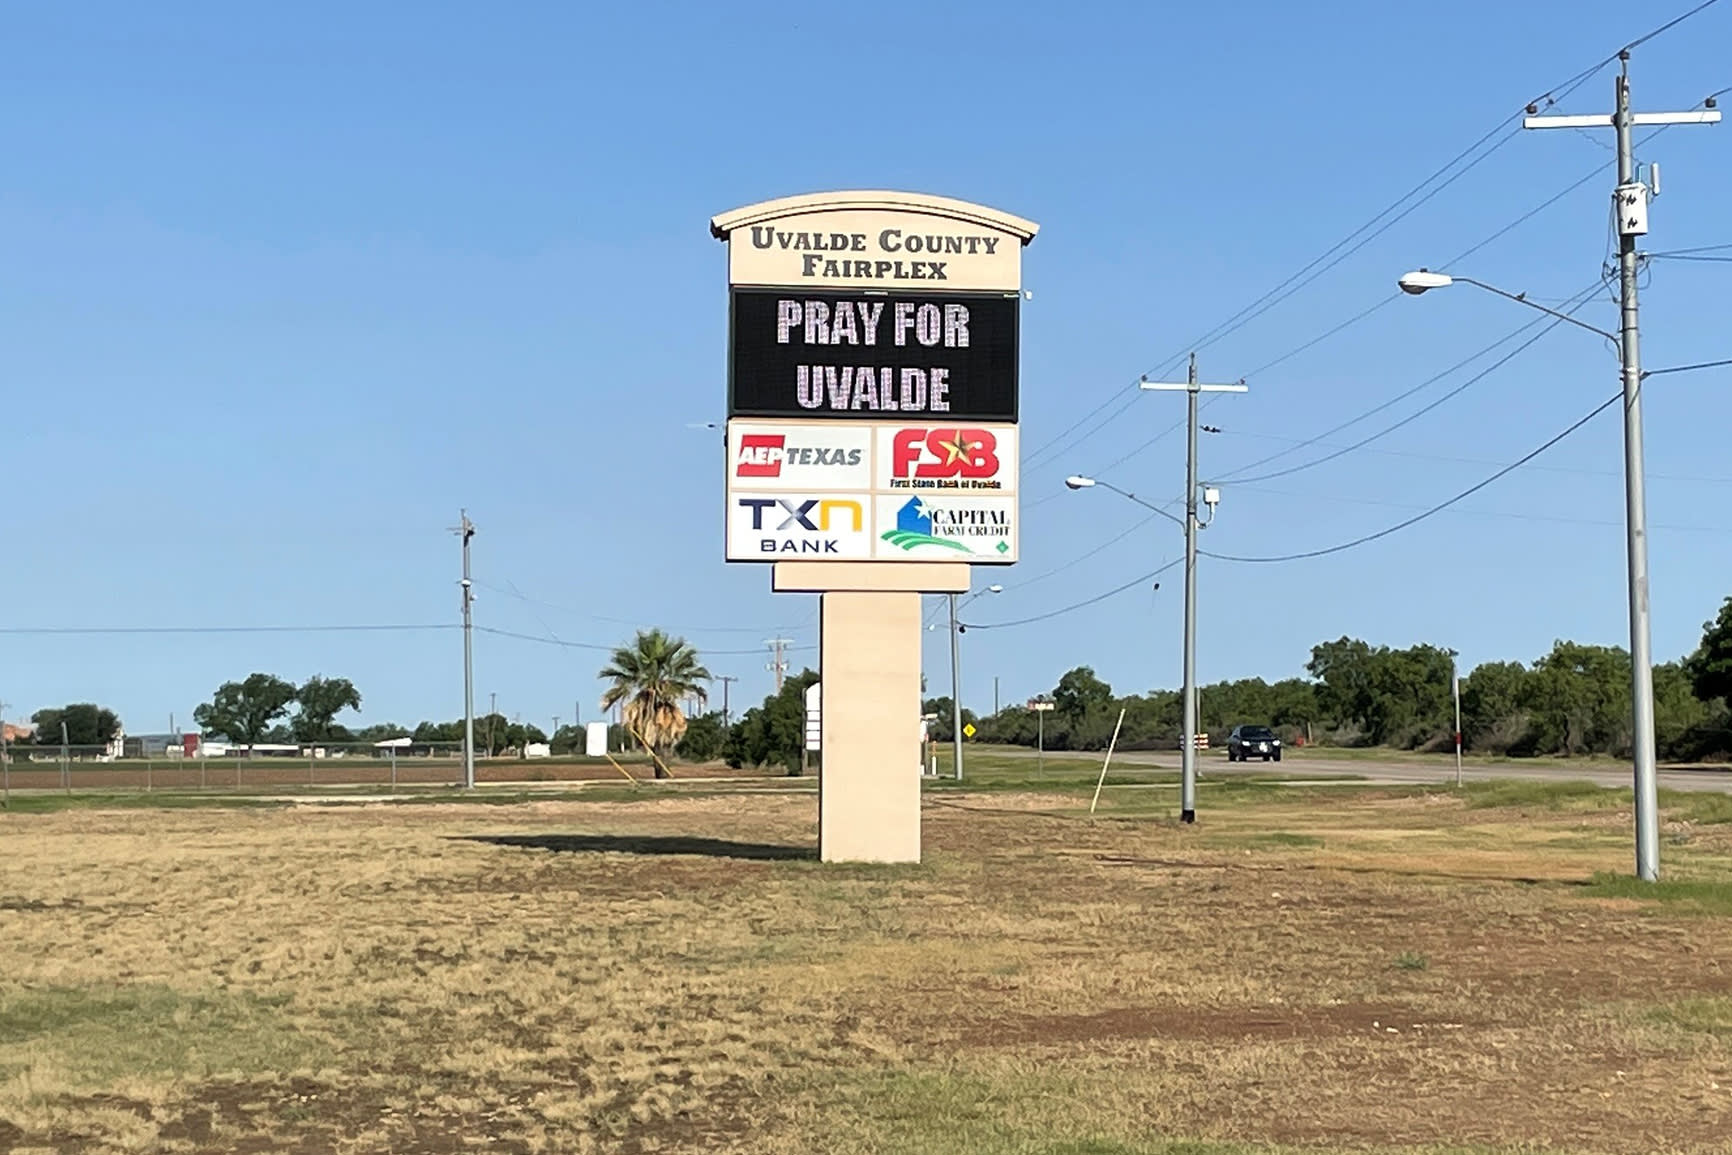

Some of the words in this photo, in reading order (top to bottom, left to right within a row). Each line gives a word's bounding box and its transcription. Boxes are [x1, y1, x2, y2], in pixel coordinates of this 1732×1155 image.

[751, 226, 867, 251] UVALDE
[879, 229, 999, 254] COUNTY
[802, 254, 947, 280] FAIRPLEX
[777, 300, 884, 345] PRAY
[895, 302, 970, 347] FOR
[797, 365, 950, 411] UVALDE
[739, 446, 784, 465] AEP
[787, 448, 862, 465] TEXAS
[893, 429, 999, 477] FSB
[933, 509, 1011, 525] CAPITAL
[934, 525, 965, 536] FARM
[968, 526, 1010, 536] CREDIT
[761, 539, 839, 553] BANK
